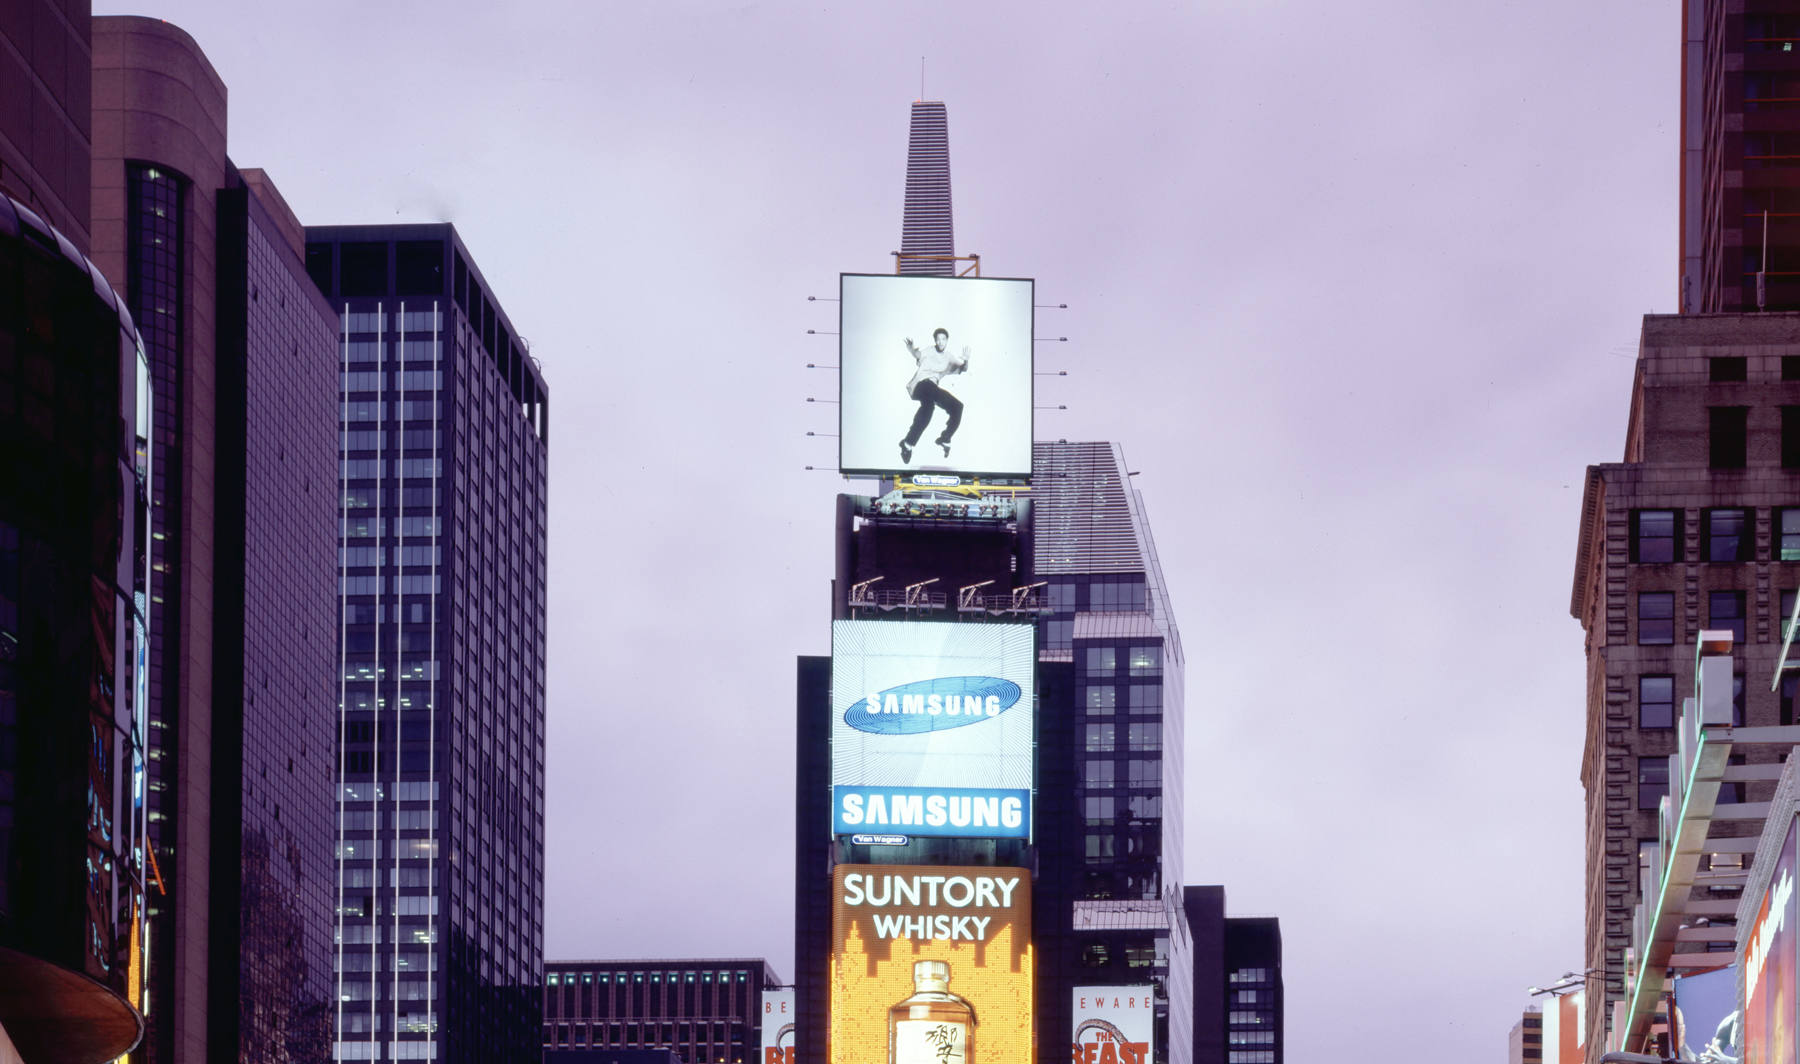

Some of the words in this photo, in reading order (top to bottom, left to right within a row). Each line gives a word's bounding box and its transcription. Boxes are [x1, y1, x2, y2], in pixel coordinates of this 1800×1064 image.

[917, 475, 930, 484] Van
[931, 475, 958, 486] Wagner
[866, 693, 1000, 717] SAMSUNG
[842, 793, 1022, 828] SAMSUNG
[858, 835, 873, 843] Van
[874, 835, 903, 845] Wagner
[844, 873, 1020, 908] SUNTORY
[873, 914, 991, 941] WHISKY
[1095, 1031, 1113, 1042] THE
